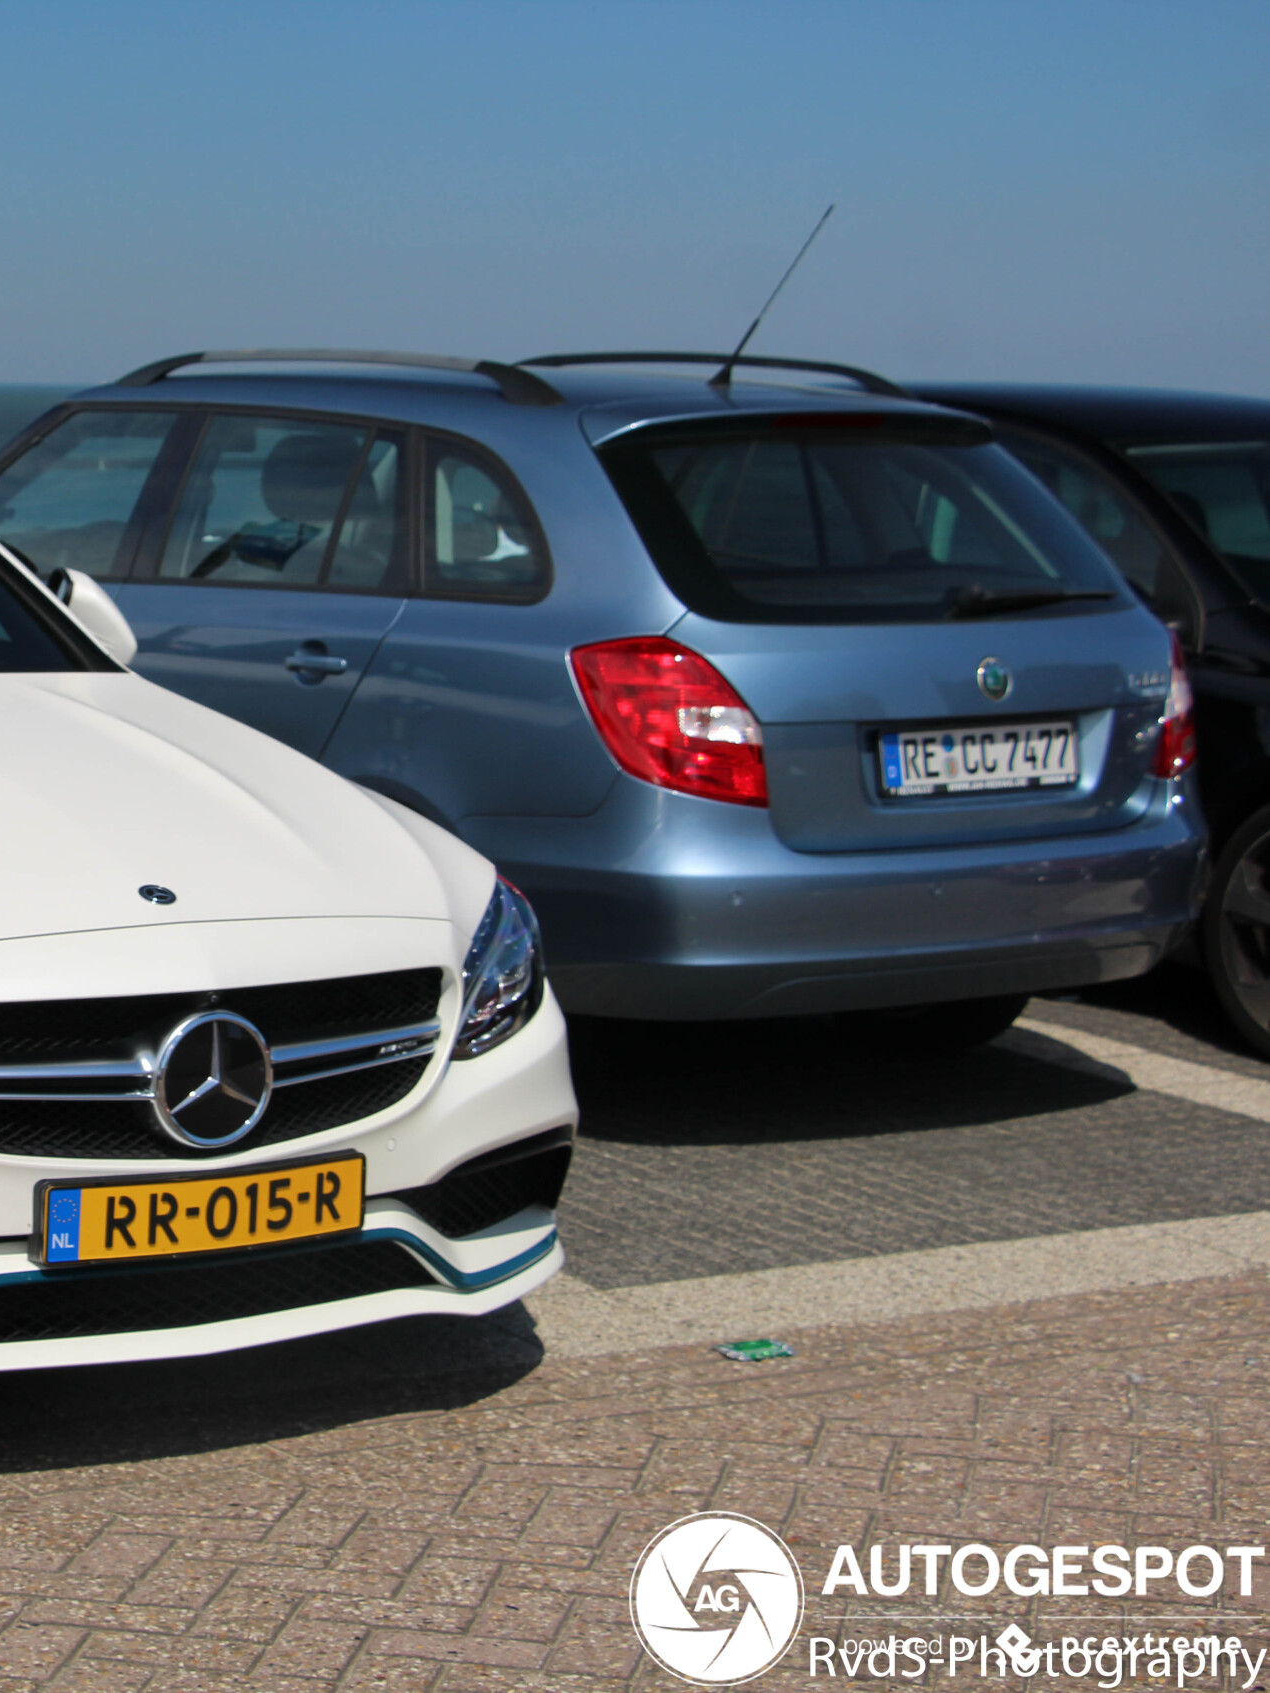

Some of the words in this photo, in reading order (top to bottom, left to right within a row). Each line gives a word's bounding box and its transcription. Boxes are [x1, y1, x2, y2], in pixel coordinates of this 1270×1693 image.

[903, 737, 940, 780] RE
[962, 733, 997, 774] CC
[1004, 728, 1069, 773] 7477
[104, 1170, 341, 1250] RR-015-R
[51, 1232, 75, 1249] NL
